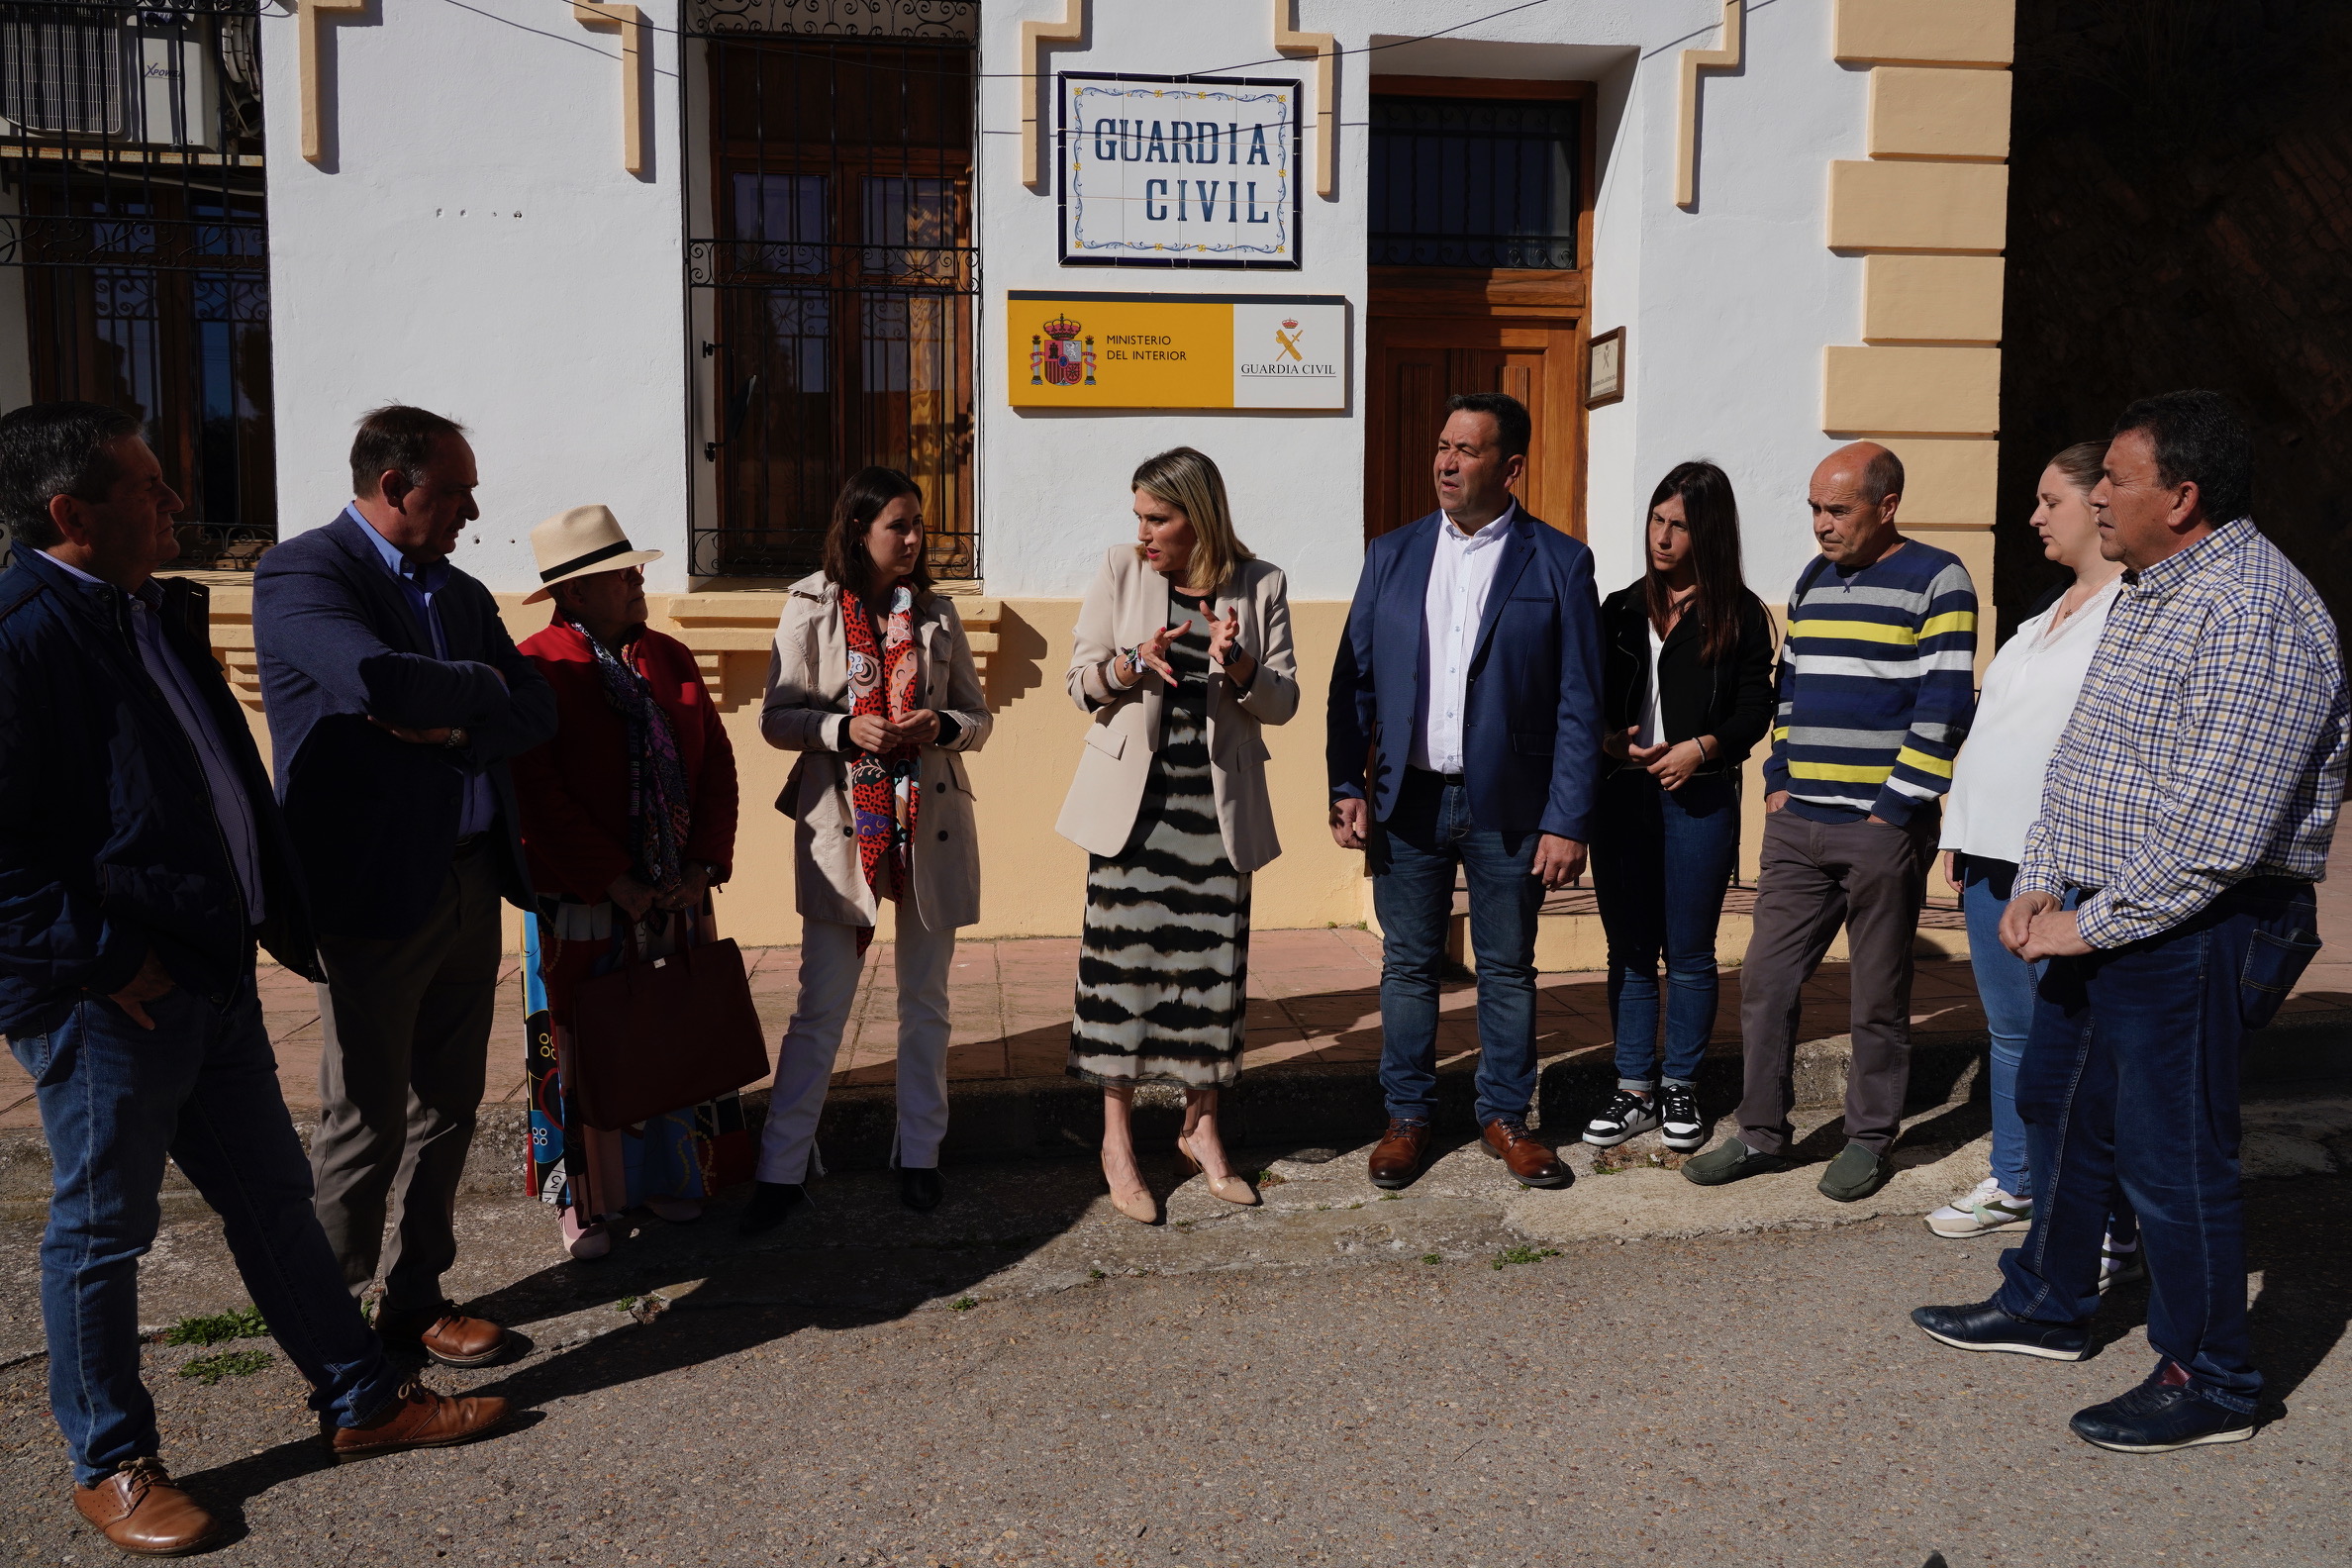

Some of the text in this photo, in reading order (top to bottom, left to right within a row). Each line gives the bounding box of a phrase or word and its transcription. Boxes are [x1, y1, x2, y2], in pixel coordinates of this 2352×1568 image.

[1095, 118, 1270, 165] GUARDIA
[1145, 179, 1270, 223] CIVIL
[1107, 335, 1172, 345] MINISTERIO
[1107, 349, 1128, 360] DEL
[1132, 350, 1187, 360] INTERIOR
[1241, 363, 1336, 375] GUARDIA CIVIL
